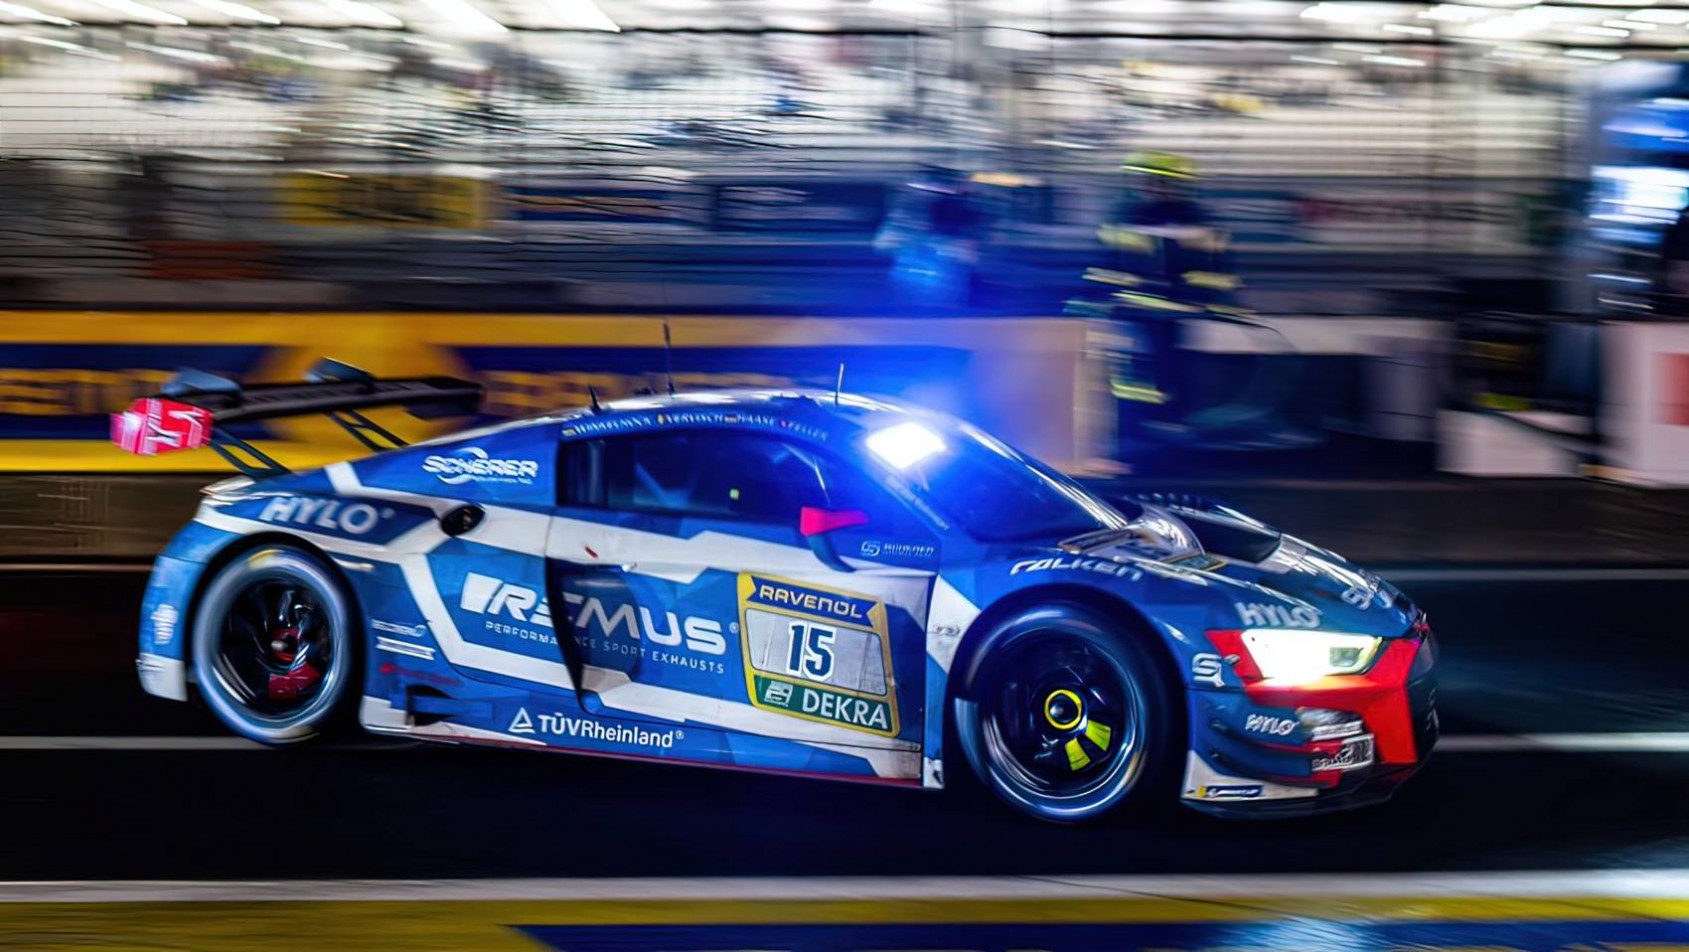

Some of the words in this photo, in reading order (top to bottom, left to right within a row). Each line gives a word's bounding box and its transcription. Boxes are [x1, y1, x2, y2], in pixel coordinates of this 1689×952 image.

[1235, 601, 1322, 629] HYLO
[602, 640, 646, 659] SPORT
[652, 650, 725, 674] EXHAUSTS
[786, 619, 837, 682] 15
[802, 688, 888, 730] DEKRA
[1244, 713, 1298, 735] HYLO
